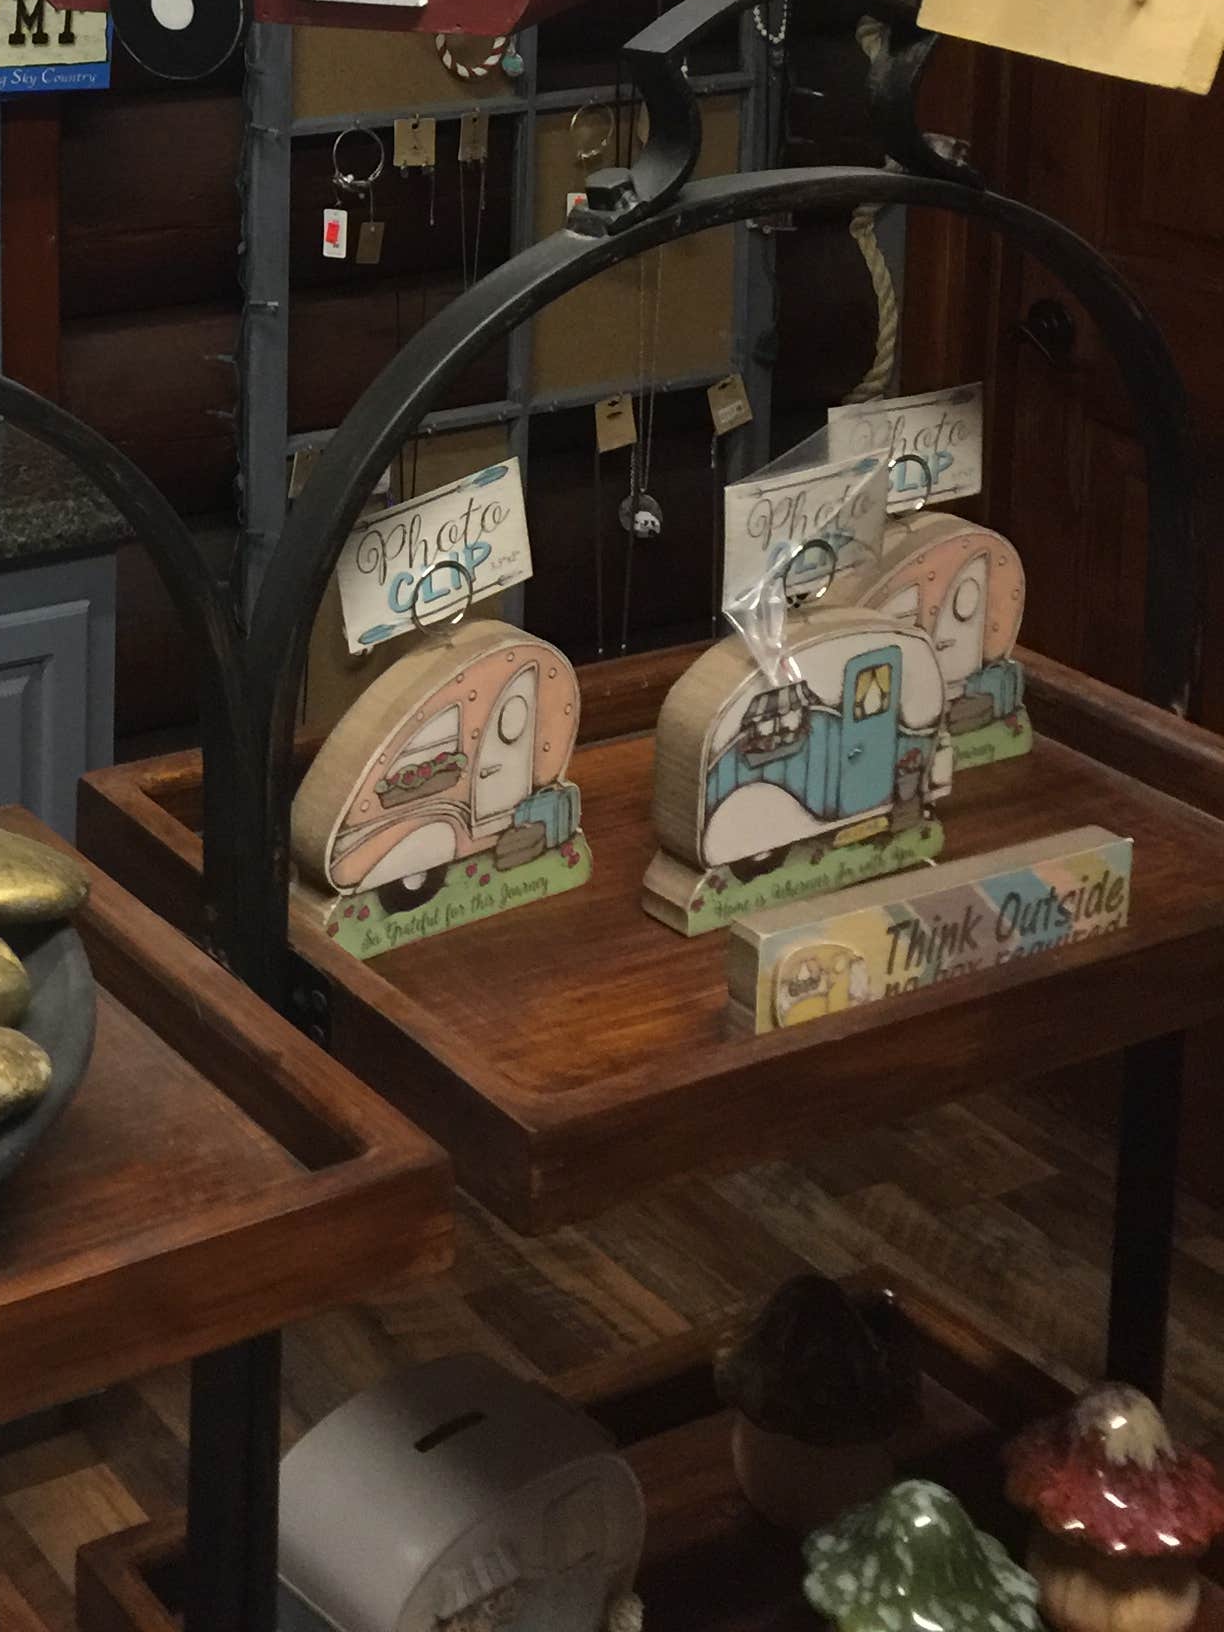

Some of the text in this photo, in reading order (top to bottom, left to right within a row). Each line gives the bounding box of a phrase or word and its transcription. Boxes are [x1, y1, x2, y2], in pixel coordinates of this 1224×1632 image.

[888, 449, 954, 492] LIP
[355, 496, 511, 586] Photo
[387, 540, 493, 614] CLIP
[885, 869, 1125, 976] Think Outside
